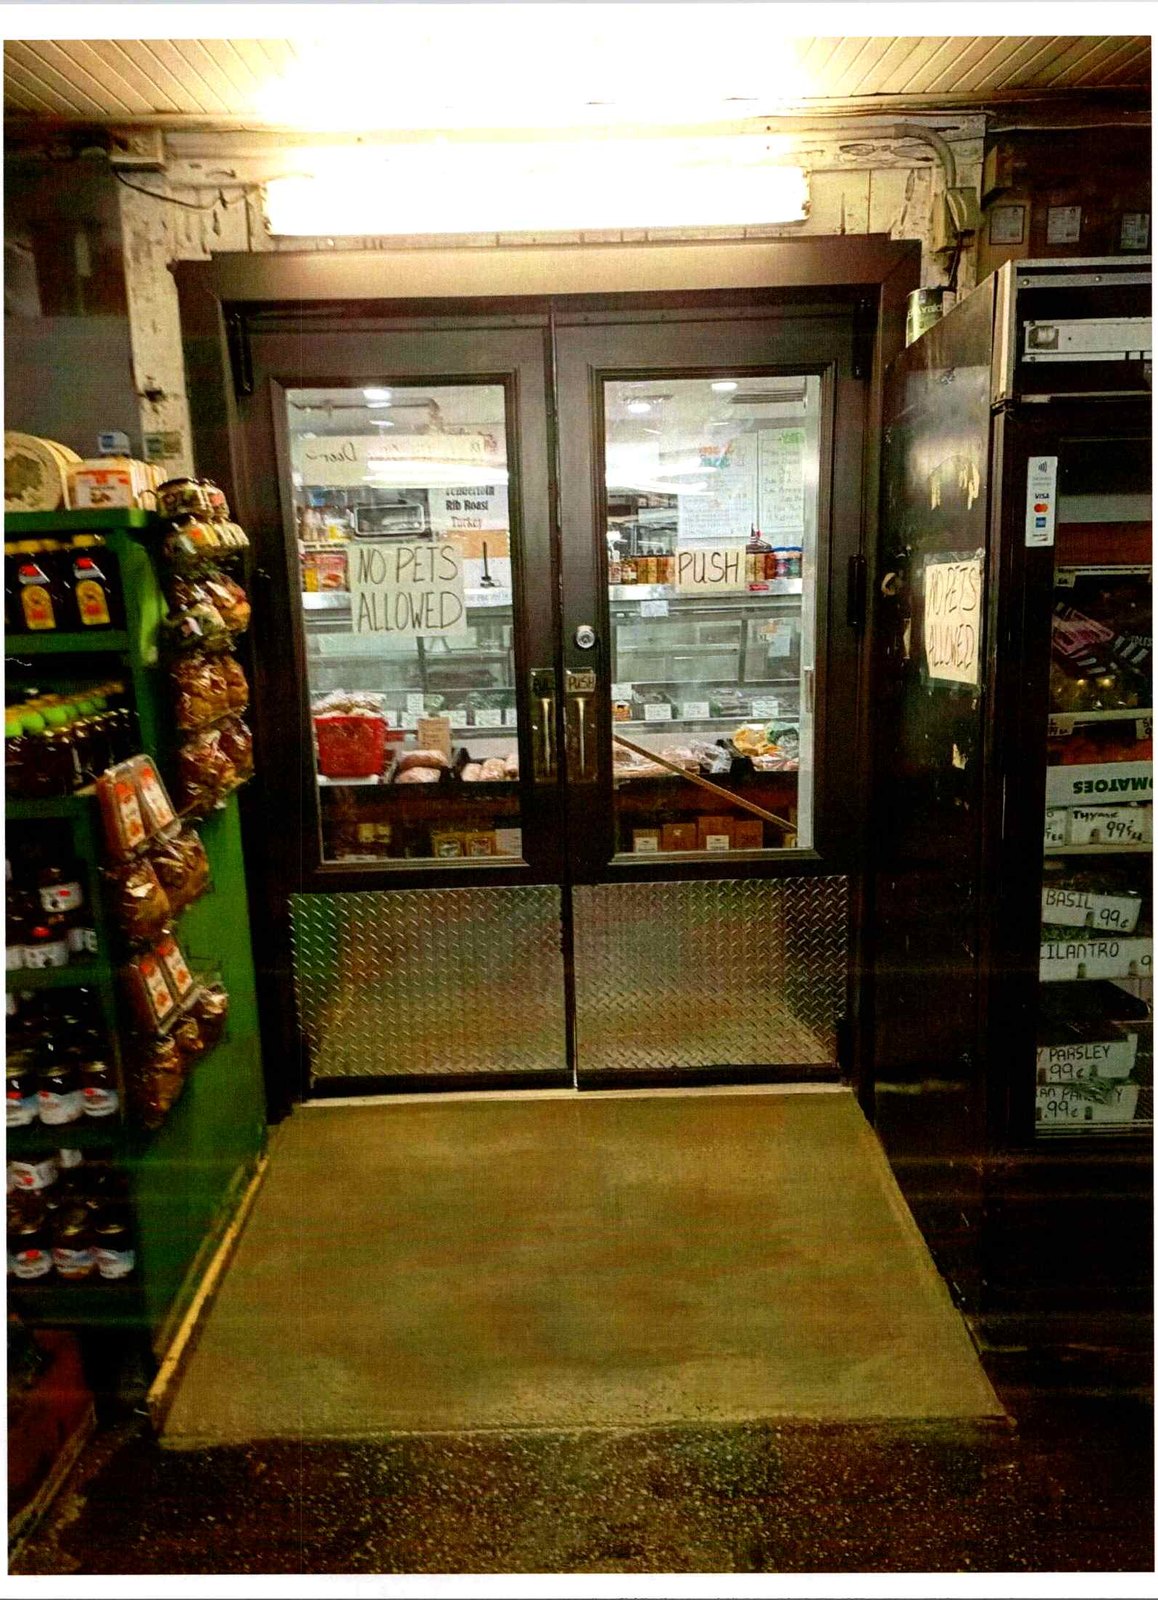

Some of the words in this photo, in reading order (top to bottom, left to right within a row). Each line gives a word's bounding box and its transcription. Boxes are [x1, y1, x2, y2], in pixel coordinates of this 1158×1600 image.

[445, 499, 462, 511] Rib
[357, 547, 387, 585] NO
[396, 544, 459, 584] PETS
[677, 551, 740, 584] PUSH
[357, 591, 463, 632] ALLOWED
[1072, 777, 1152, 795] MATOES
[1045, 889, 1095, 910] BASIL
[1049, 1044, 1110, 1062] PARSLEY
